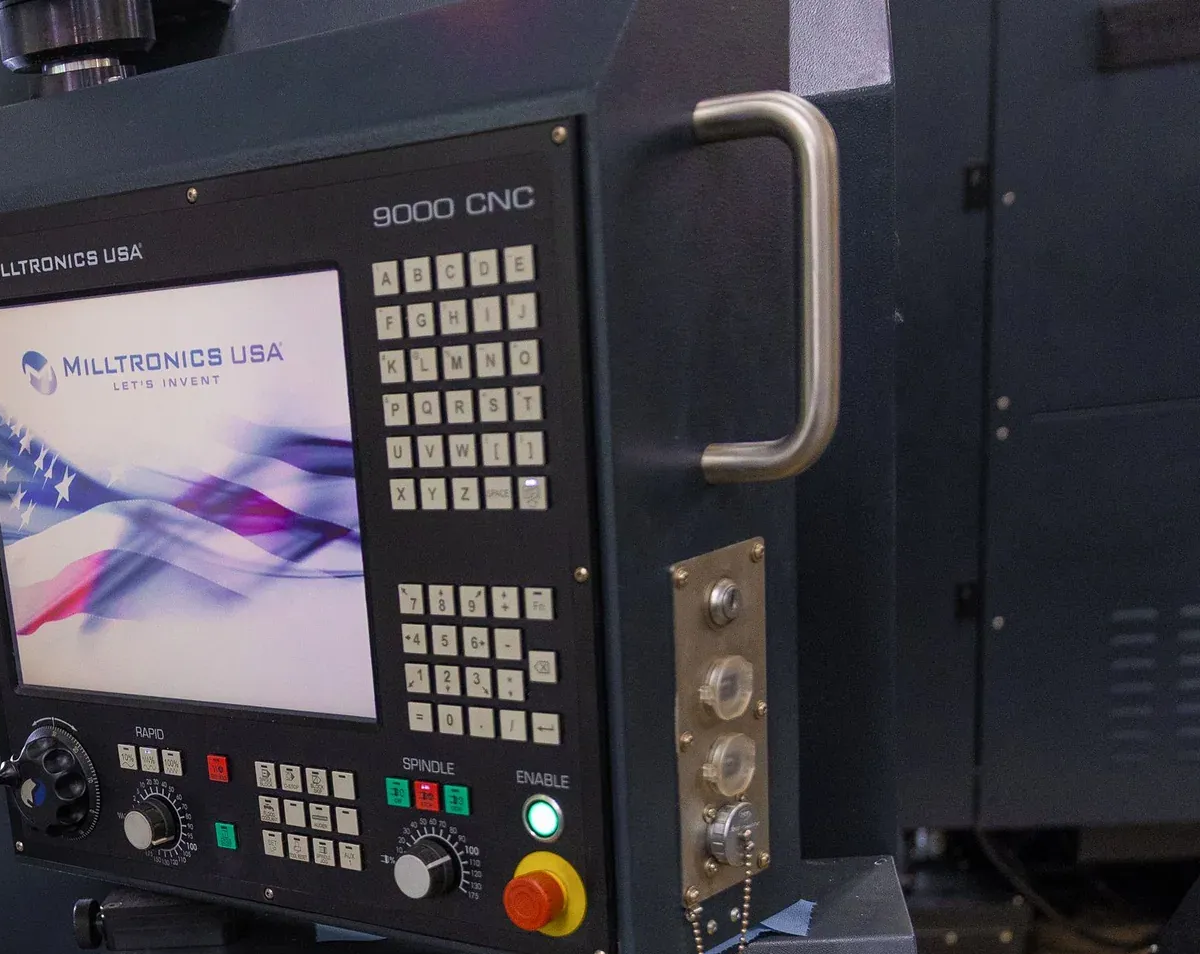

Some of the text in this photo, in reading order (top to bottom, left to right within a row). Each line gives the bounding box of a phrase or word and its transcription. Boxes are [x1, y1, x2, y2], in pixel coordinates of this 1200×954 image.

[373, 185, 535, 228] 9000 CNC
[381, 257, 524, 286] A B C D E
[386, 305, 526, 330] F G H I J
[387, 350, 531, 374] K L M N O
[113, 375, 221, 391] LET'S INVENT
[391, 396, 532, 416] P Q R S T
[393, 445, 402, 459] U
[425, 445, 434, 458] V
[456, 444, 469, 457] W
[396, 487, 406, 500] X
[428, 487, 437, 500] Y
[461, 487, 470, 501] Z
[410, 598, 417, 610] 7
[438, 599, 446, 611] 8
[468, 600, 476, 612] 9
[413, 634, 420, 645] 4
[441, 635, 448, 646] 5
[471, 637, 478, 649] 6
[443, 670, 451, 683] 2
[473, 672, 481, 685] 3
[447, 714, 454, 727] 0
[135, 726, 164, 740] RAPID
[121, 753, 135, 762] 10%
[164, 758, 179, 768] 100%
[402, 757, 455, 775] SPINDLE
[516, 769, 570, 790] ENABLE
[410, 820, 418, 828] 40
[439, 820, 446, 828] 70
[449, 826, 457, 834] 80
[398, 836, 406, 844] 20
[458, 834, 466, 842] 90
[464, 845, 479, 855] 100
[469, 859, 480, 867] 110
[471, 869, 482, 878] 120
[471, 881, 482, 890] 130
[468, 891, 479, 900] 175
